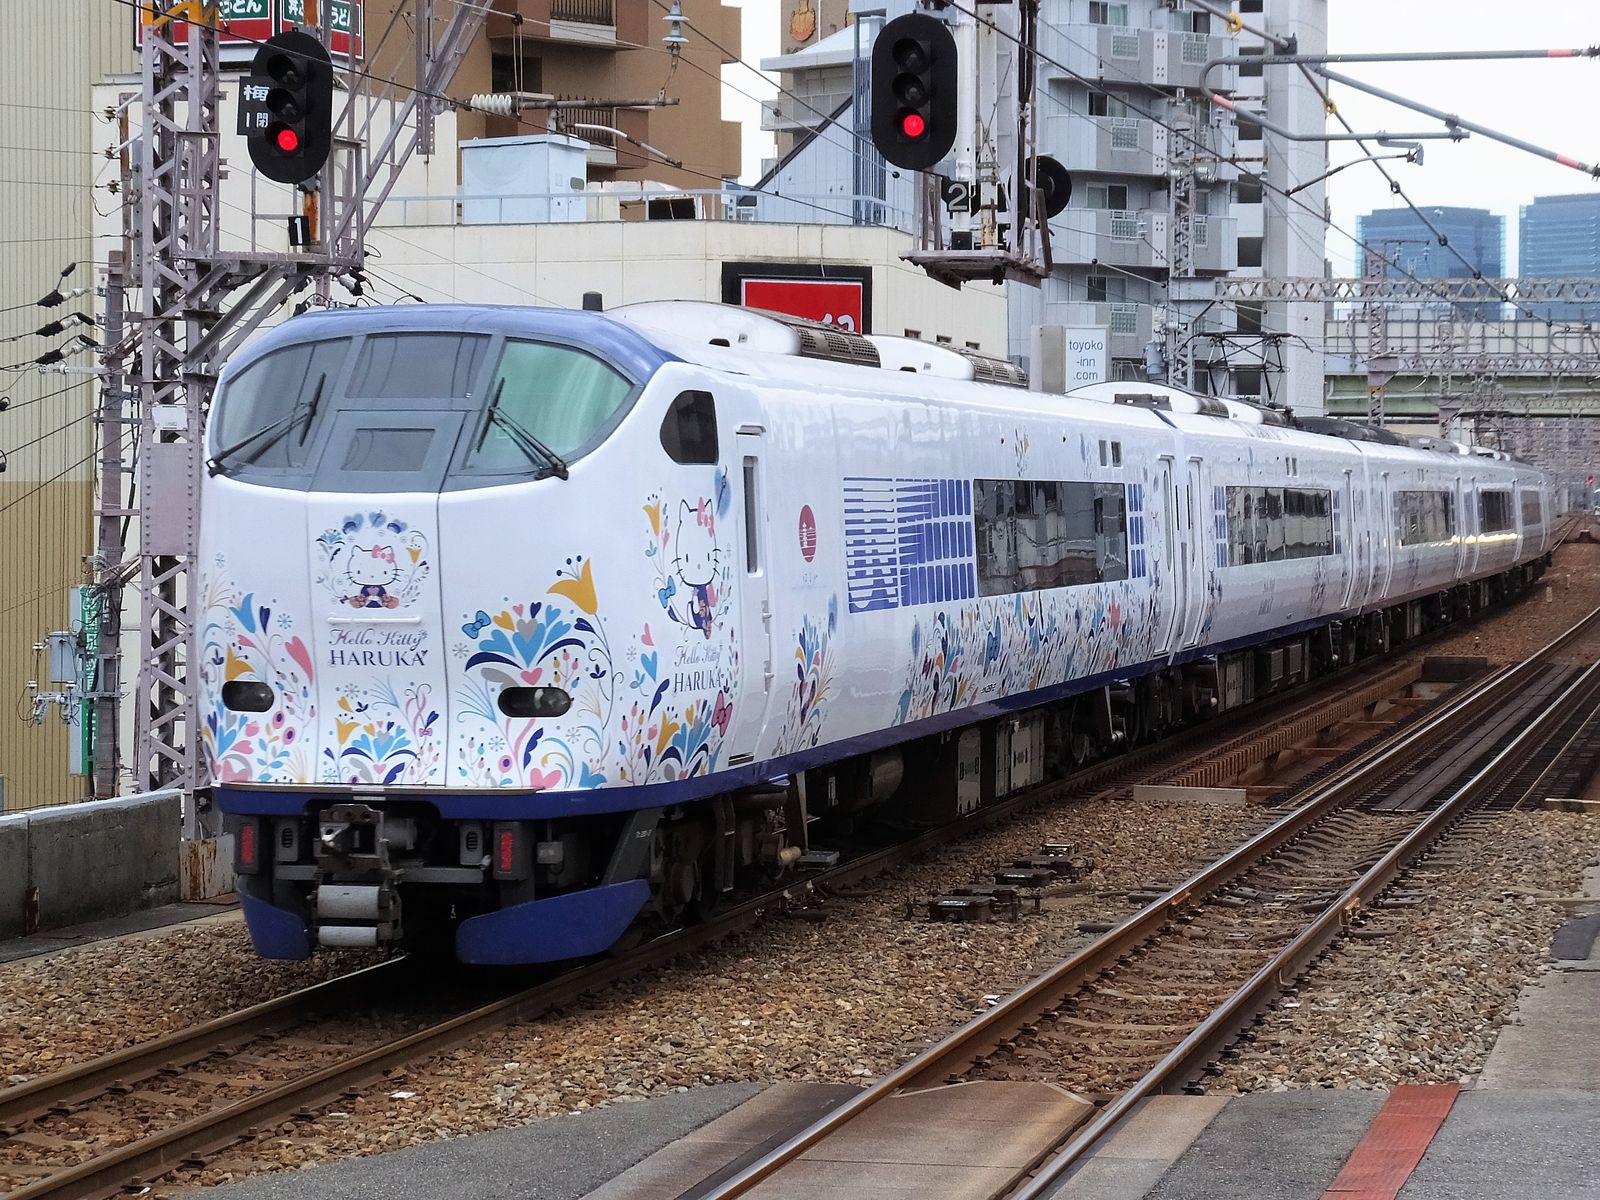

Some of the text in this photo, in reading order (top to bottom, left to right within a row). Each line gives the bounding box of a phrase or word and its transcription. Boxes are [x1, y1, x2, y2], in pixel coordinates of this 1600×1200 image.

[243, 84, 270, 101] 梅
[948, 183, 968, 211] 2
[1069, 340, 1103, 353] toyoko
[1076, 356, 1096, 367] -inn
[1073, 371, 1098, 381] .com
[328, 628, 423, 652] Hello Kitty
[330, 649, 425, 667] HARUKA
[674, 645, 701, 667] Hello
[674, 669, 721, 692] HARUKA
